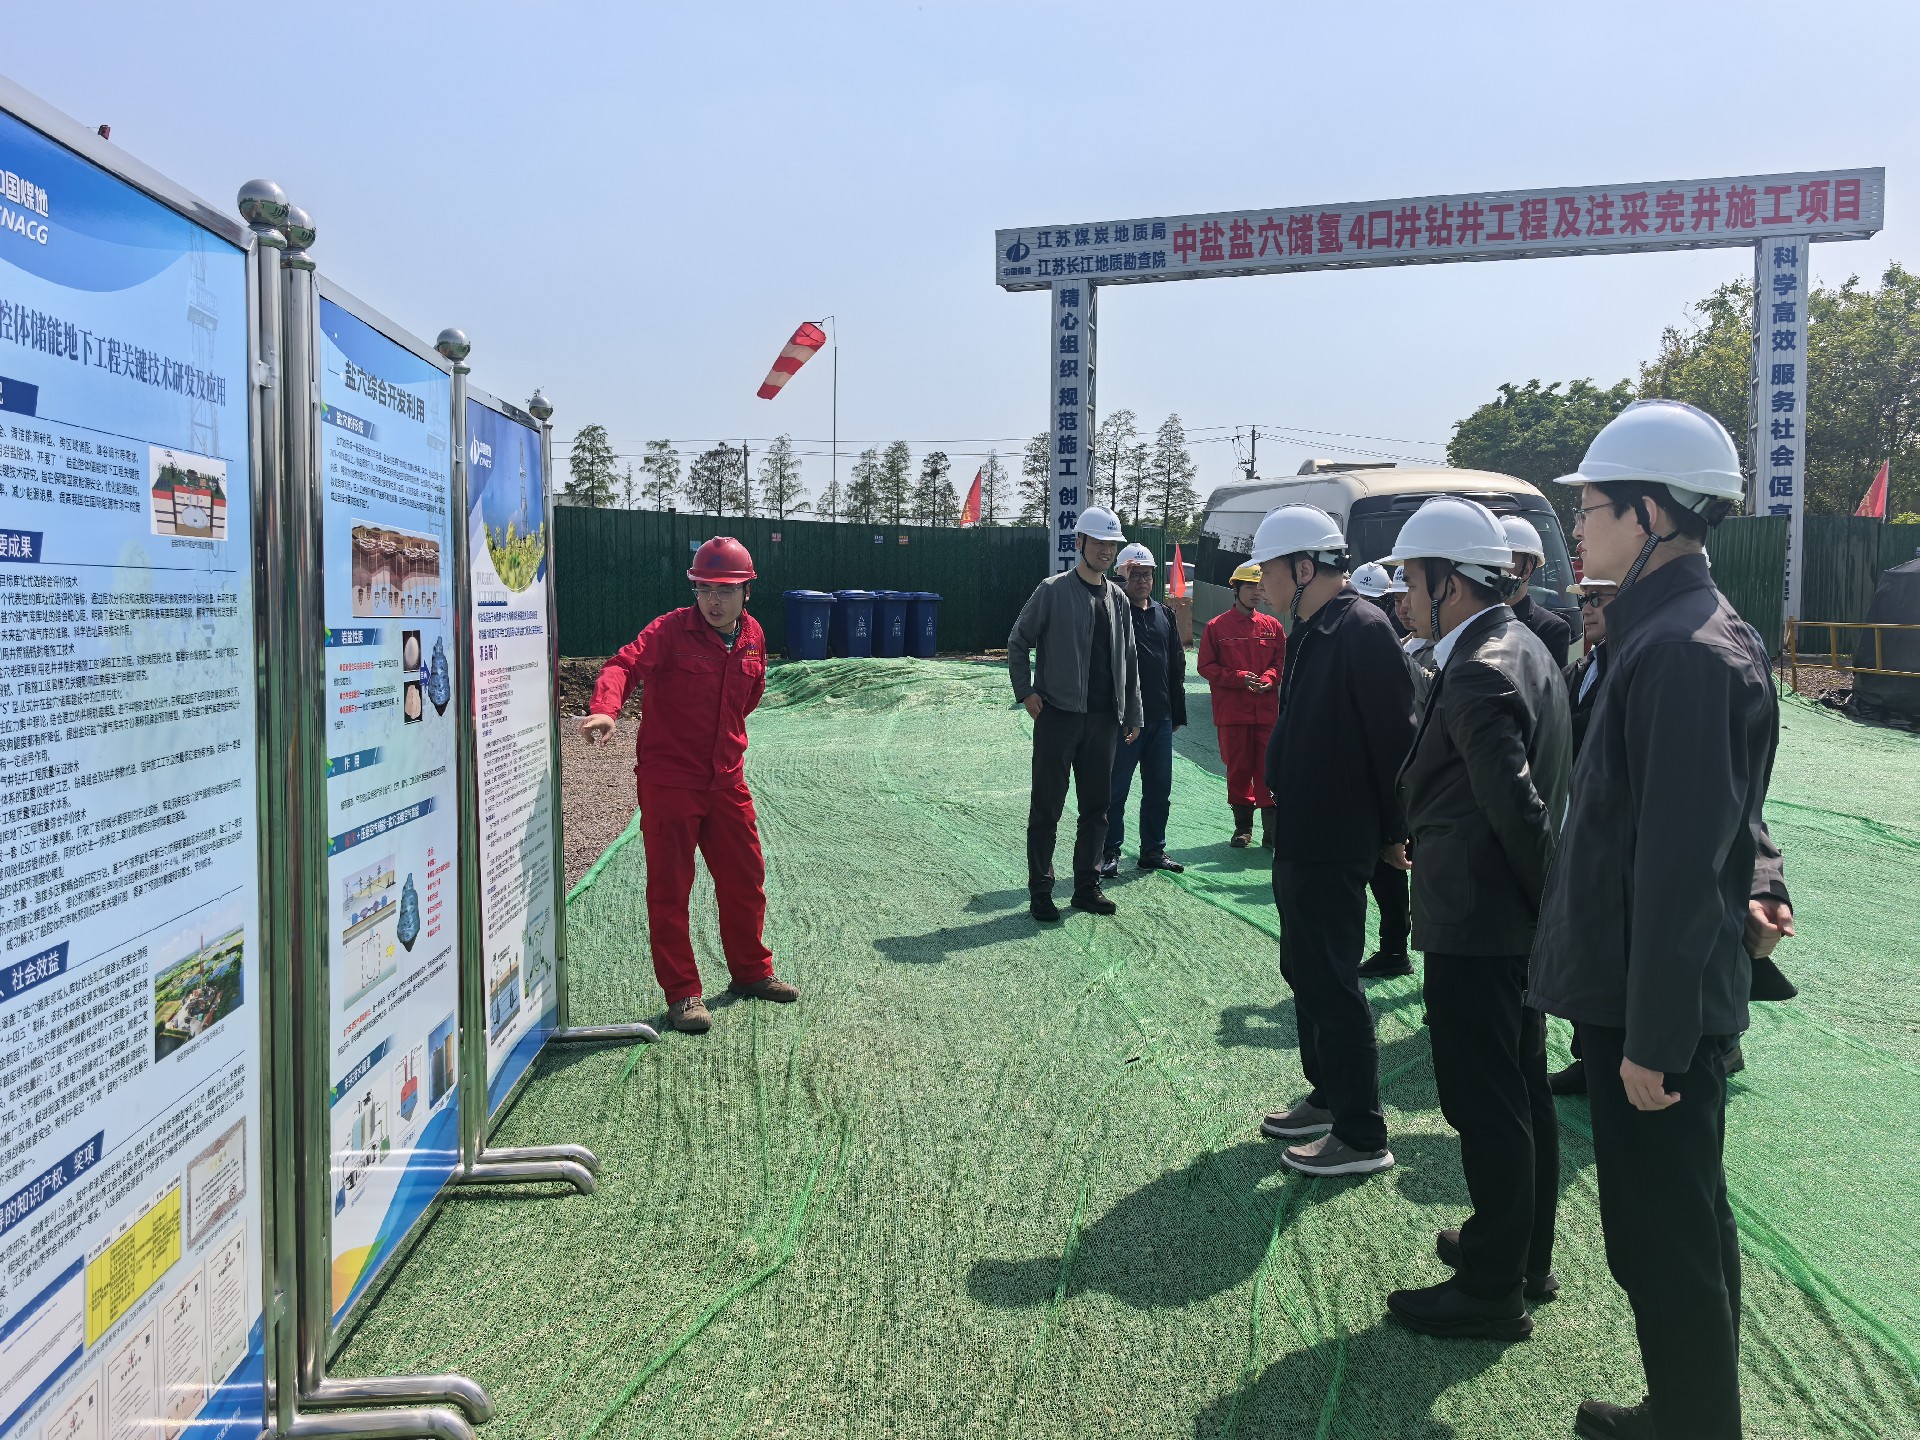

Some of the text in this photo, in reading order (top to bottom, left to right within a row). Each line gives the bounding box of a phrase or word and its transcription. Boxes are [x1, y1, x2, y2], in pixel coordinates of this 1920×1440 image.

[0, 205, 49, 245] NACG
[1037, 222, 1167, 249] 江苏煤炭地质局
[1038, 250, 1167, 276] 江苏长江地质勘查院
[1059, 288, 1080, 379] 精心组织
[1771, 246, 1798, 352] 科学高效
[344, 358, 424, 425] 盐穴综合开发利用
[1769, 363, 1796, 467] 服务社会
[1058, 387, 1079, 477] 规范施工
